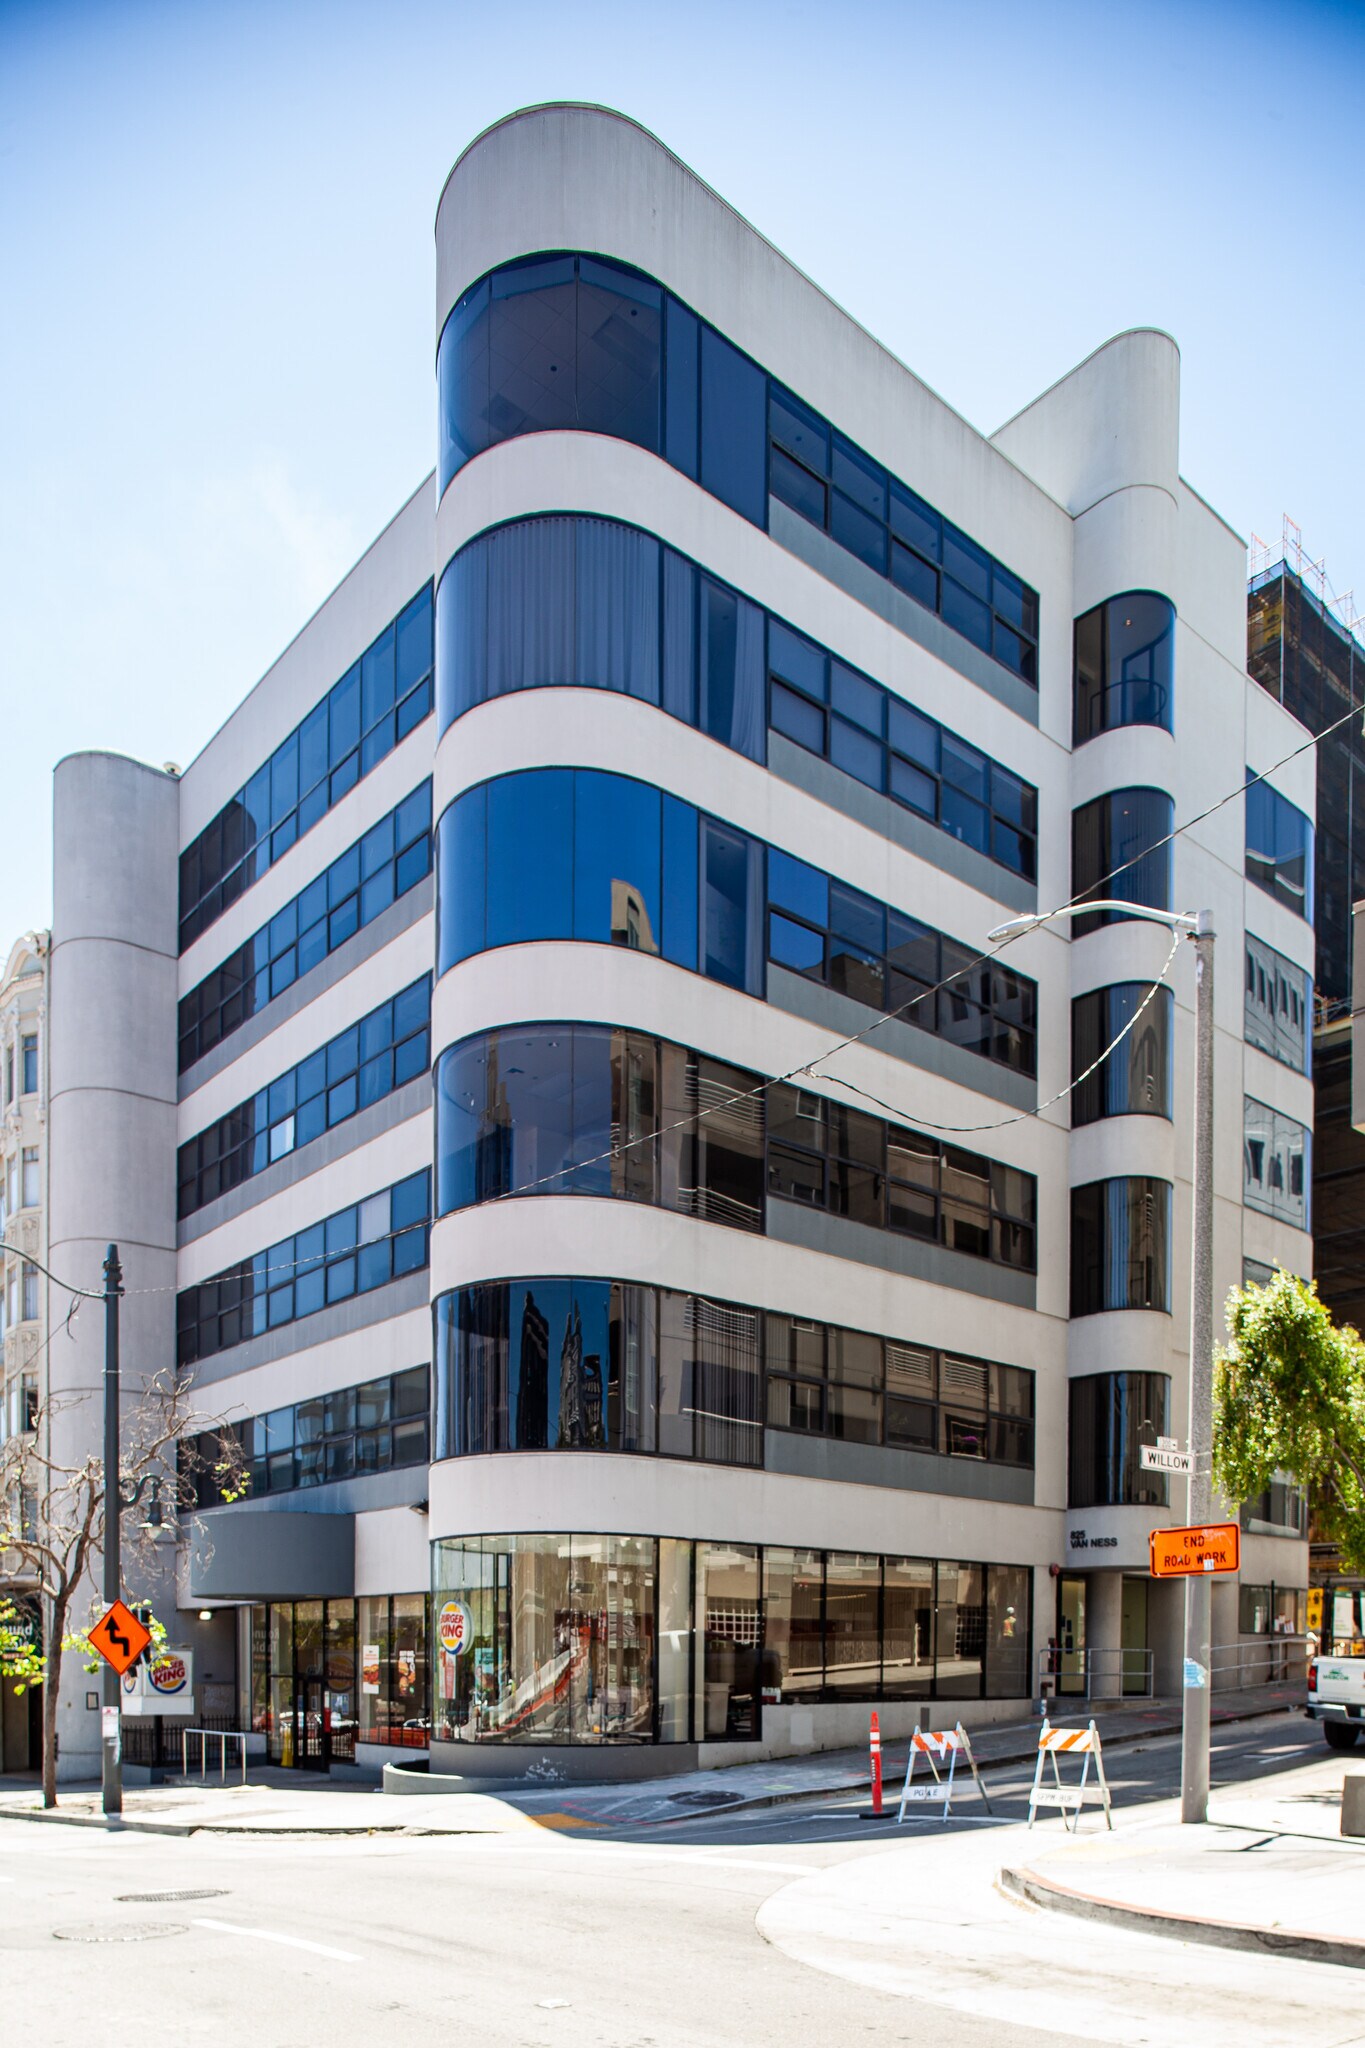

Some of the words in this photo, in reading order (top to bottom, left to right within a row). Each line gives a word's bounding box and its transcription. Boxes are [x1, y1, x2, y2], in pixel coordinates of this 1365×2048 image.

[1148, 1452, 1189, 1469] WILLOW
[1070, 1530, 1085, 1540] 825
[1070, 1540, 1088, 1549] VAN
[1090, 1538, 1118, 1548] NESS
[1184, 1536, 1204, 1548] END
[1164, 1555, 1191, 1567] ROAD
[440, 1613, 464, 1624] BURGER
[440, 1625, 463, 1638] KING
[154, 1667, 185, 1686] KING
